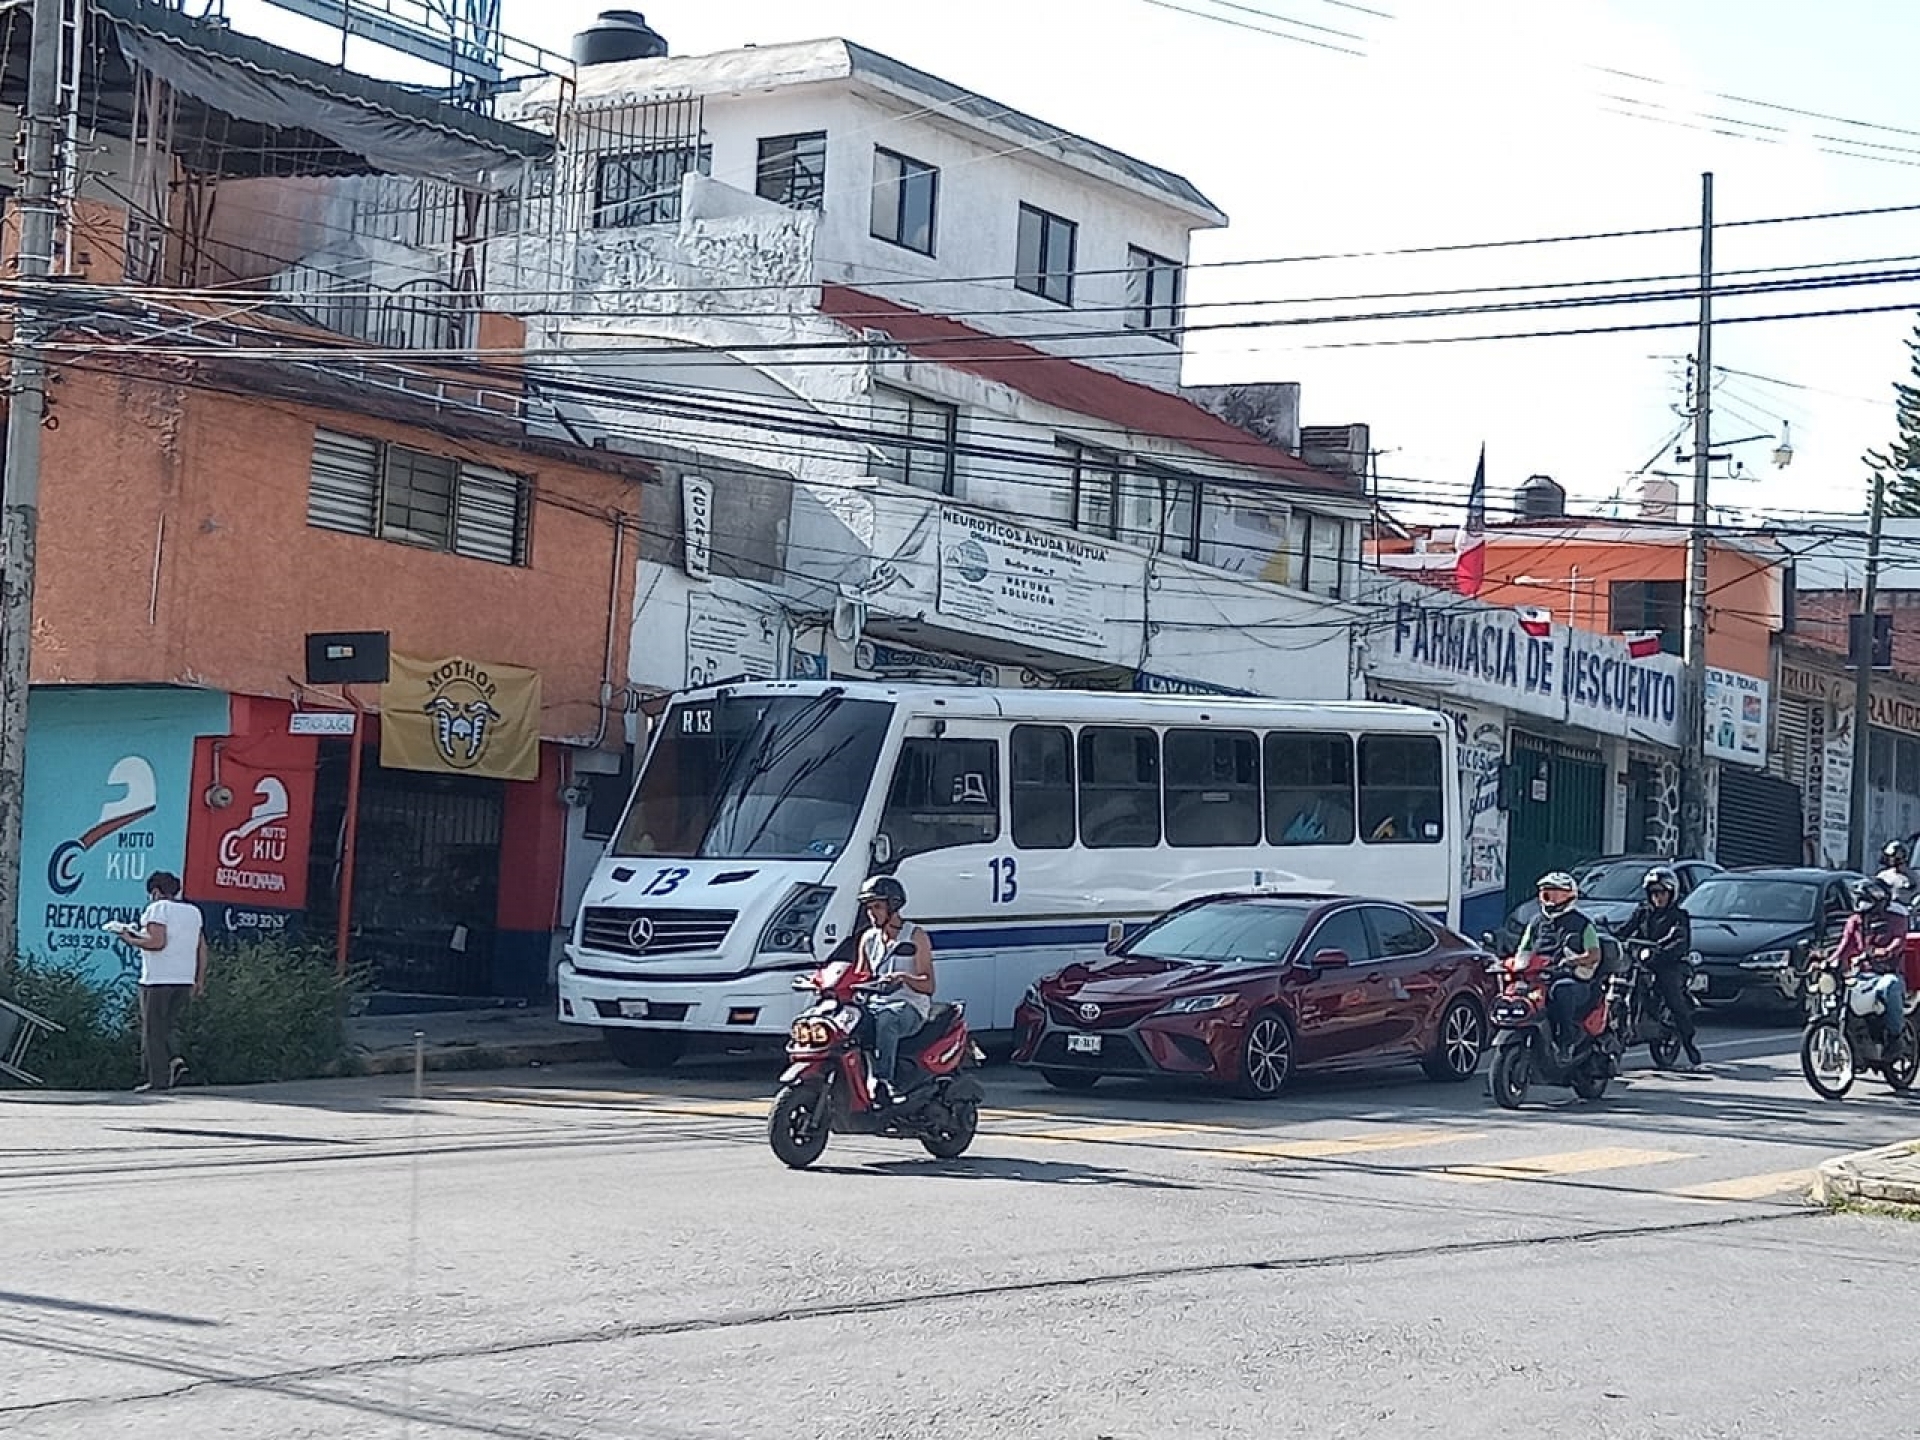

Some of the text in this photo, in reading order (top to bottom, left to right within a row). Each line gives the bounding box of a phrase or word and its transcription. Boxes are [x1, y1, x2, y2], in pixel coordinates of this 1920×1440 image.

[1395, 600, 1517, 690] FARMACIA
[1525, 637, 1555, 696] DE
[1562, 647, 1676, 726] DESCUENTO
[426, 660, 498, 700] MOTHOR
[683, 710, 712, 733] R 13
[118, 832, 154, 848] MOTO
[260, 827, 287, 839] MOTO
[252, 839, 286, 861] KIU
[107, 852, 145, 880] KIU
[988, 857, 1017, 903] 13
[641, 868, 690, 896] 13
